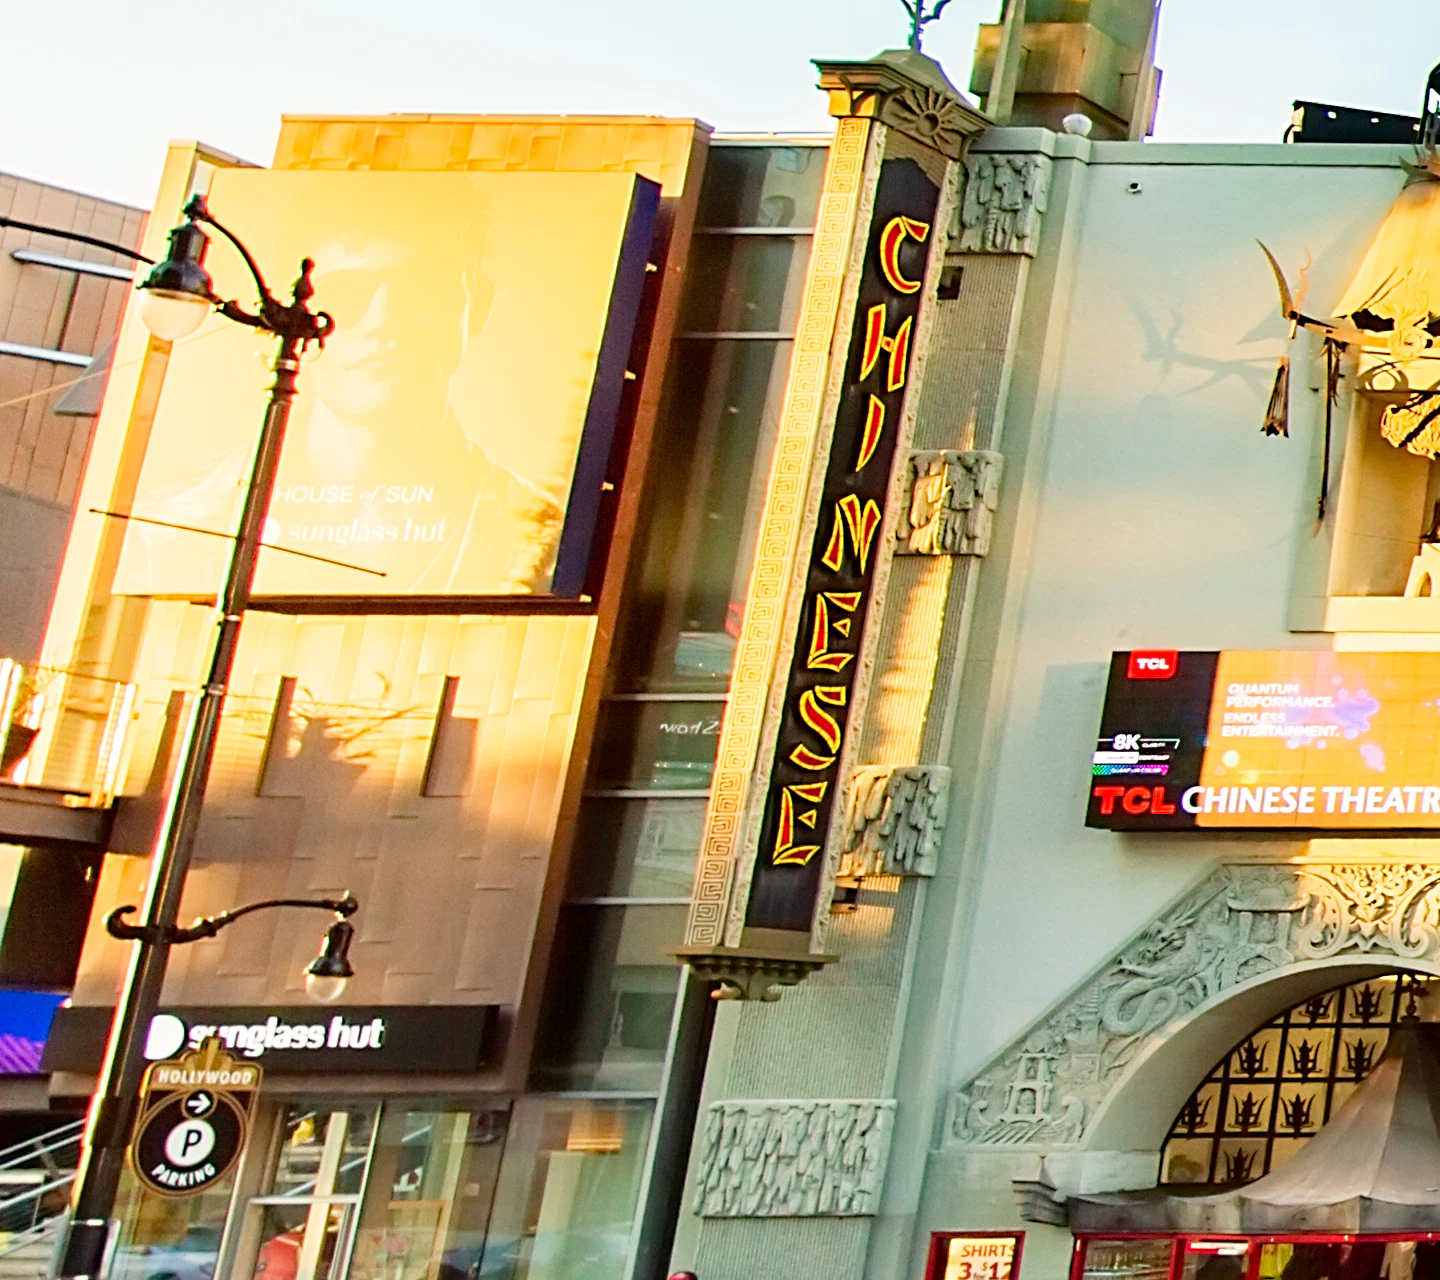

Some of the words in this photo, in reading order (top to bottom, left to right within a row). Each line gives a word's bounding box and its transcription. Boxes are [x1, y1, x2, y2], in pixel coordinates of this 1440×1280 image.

[274, 485, 355, 503] HOUSE
[359, 484, 385, 505] of
[385, 485, 434, 503] SUN
[287, 518, 398, 549] sunglass
[403, 518, 446, 542] hut
[772, 216, 930, 866] CHINESE
[1137, 658, 1170, 670] TCL
[1227, 683, 1300, 696] QUANTUM
[1225, 696, 1336, 709] PERFORMANCE.
[1223, 712, 1286, 724] ENDLESS
[1221, 725, 1341, 738] ENTERTAINMENT.
[1113, 734, 1141, 750] 8K
[1094, 785, 1176, 815] TCL
[1181, 785, 1316, 814] CHINESE
[326, 1016, 385, 1049] hut
[158, 1069, 252, 1086] HOLLYWOOD
[181, 1129, 203, 1157] P
[151, 1163, 216, 1187] PARKING
[957, 1262, 972, 1280] 3
[973, 1273, 986, 1280] for
